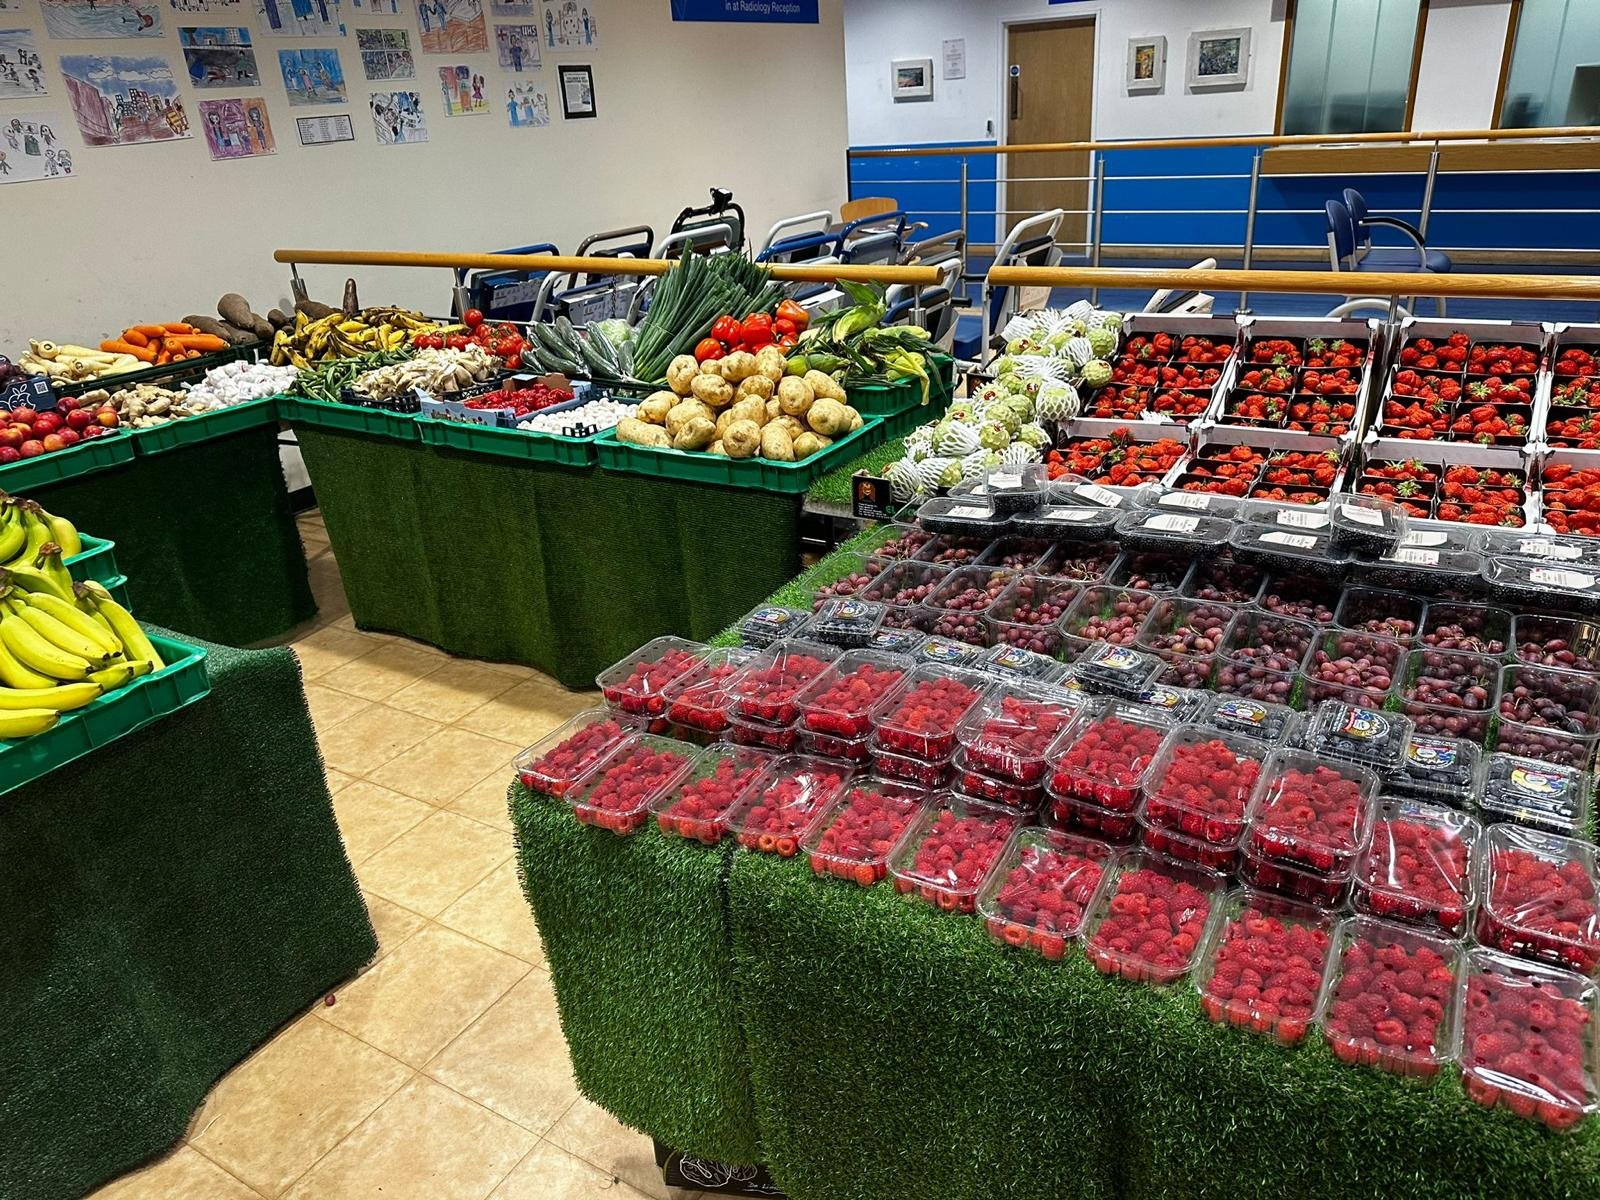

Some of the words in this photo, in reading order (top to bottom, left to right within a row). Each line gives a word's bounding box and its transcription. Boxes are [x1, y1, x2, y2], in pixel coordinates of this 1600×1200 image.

[732, 2, 739, 11] at
[740, 1, 771, 14] Radiology
[771, 2, 800, 14] Reception
